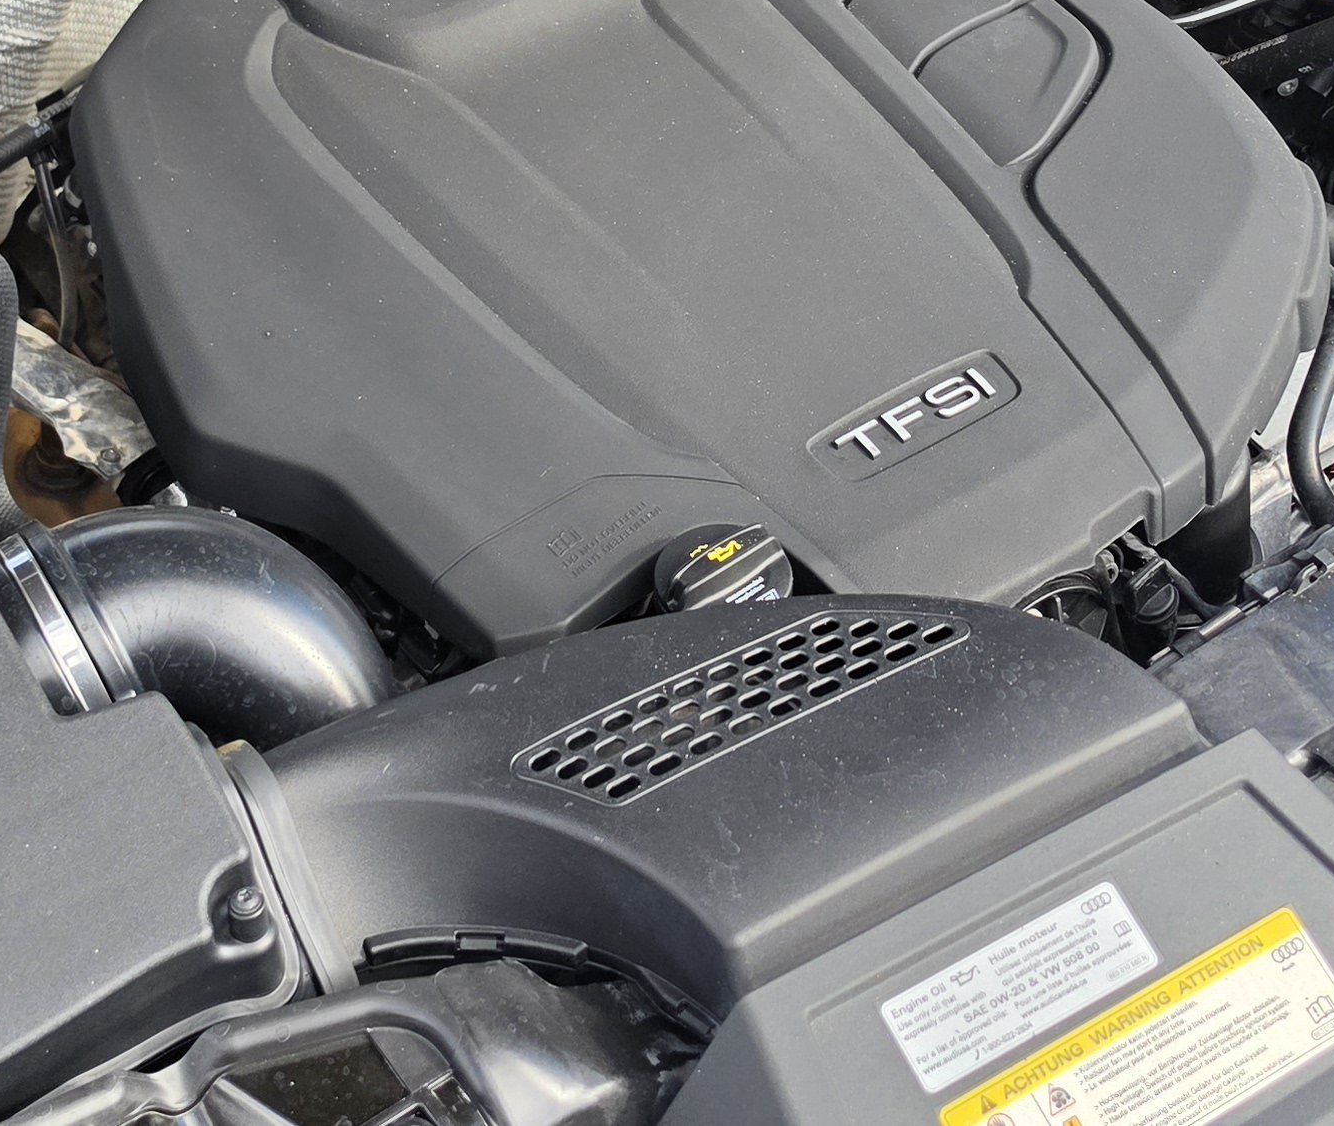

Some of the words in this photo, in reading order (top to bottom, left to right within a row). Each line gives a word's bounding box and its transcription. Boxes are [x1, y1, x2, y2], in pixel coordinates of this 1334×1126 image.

[834, 368, 997, 460] TFSI
[988, 946, 1016, 964] Huile
[1018, 922, 1056, 948] moteur
[890, 994, 928, 1018] Engine
[930, 982, 946, 996] Oil
[963, 1004, 988, 1022] SAE
[989, 983, 1026, 1008] 0W-20
[1039, 962, 1060, 978] VW
[1062, 950, 1083, 966] 508
[1085, 941, 1099, 954] 00
[913, 1009, 930, 1022] only
[1004, 1043, 1084, 1099] ACHTUNG
[1088, 991, 1170, 1044] WARNING
[1179, 936, 1263, 993] ATTENTION
